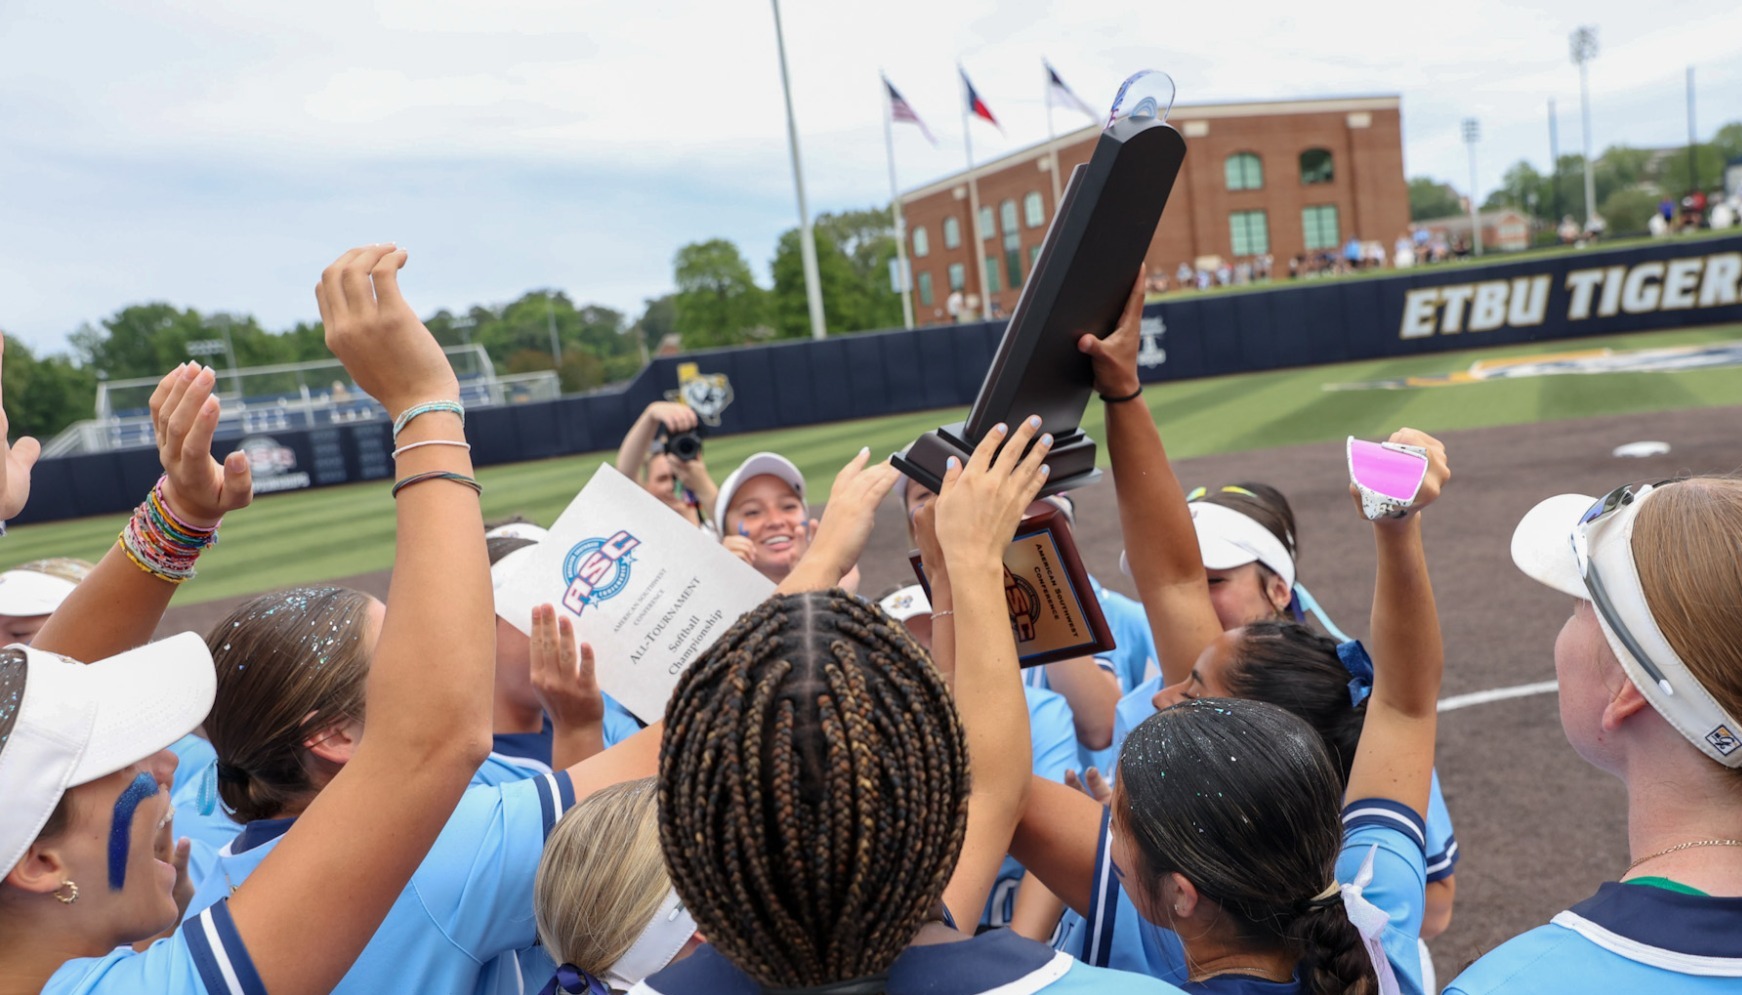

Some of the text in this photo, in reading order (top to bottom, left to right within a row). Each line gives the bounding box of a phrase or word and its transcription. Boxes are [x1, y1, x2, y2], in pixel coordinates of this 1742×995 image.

[1400, 252, 1742, 338] ETBU TIGER
[562, 530, 641, 617] ASC
[613, 567, 667, 633] AMERICAN SOUTHWEST
[1034, 566, 1060, 621] CONFERENCE
[1035, 543, 1079, 638] AMERICAN SOUTHWEST
[633, 588, 665, 627] CONFERENCE
[668, 614, 700, 653] Softball
[667, 608, 723, 677] Championship
